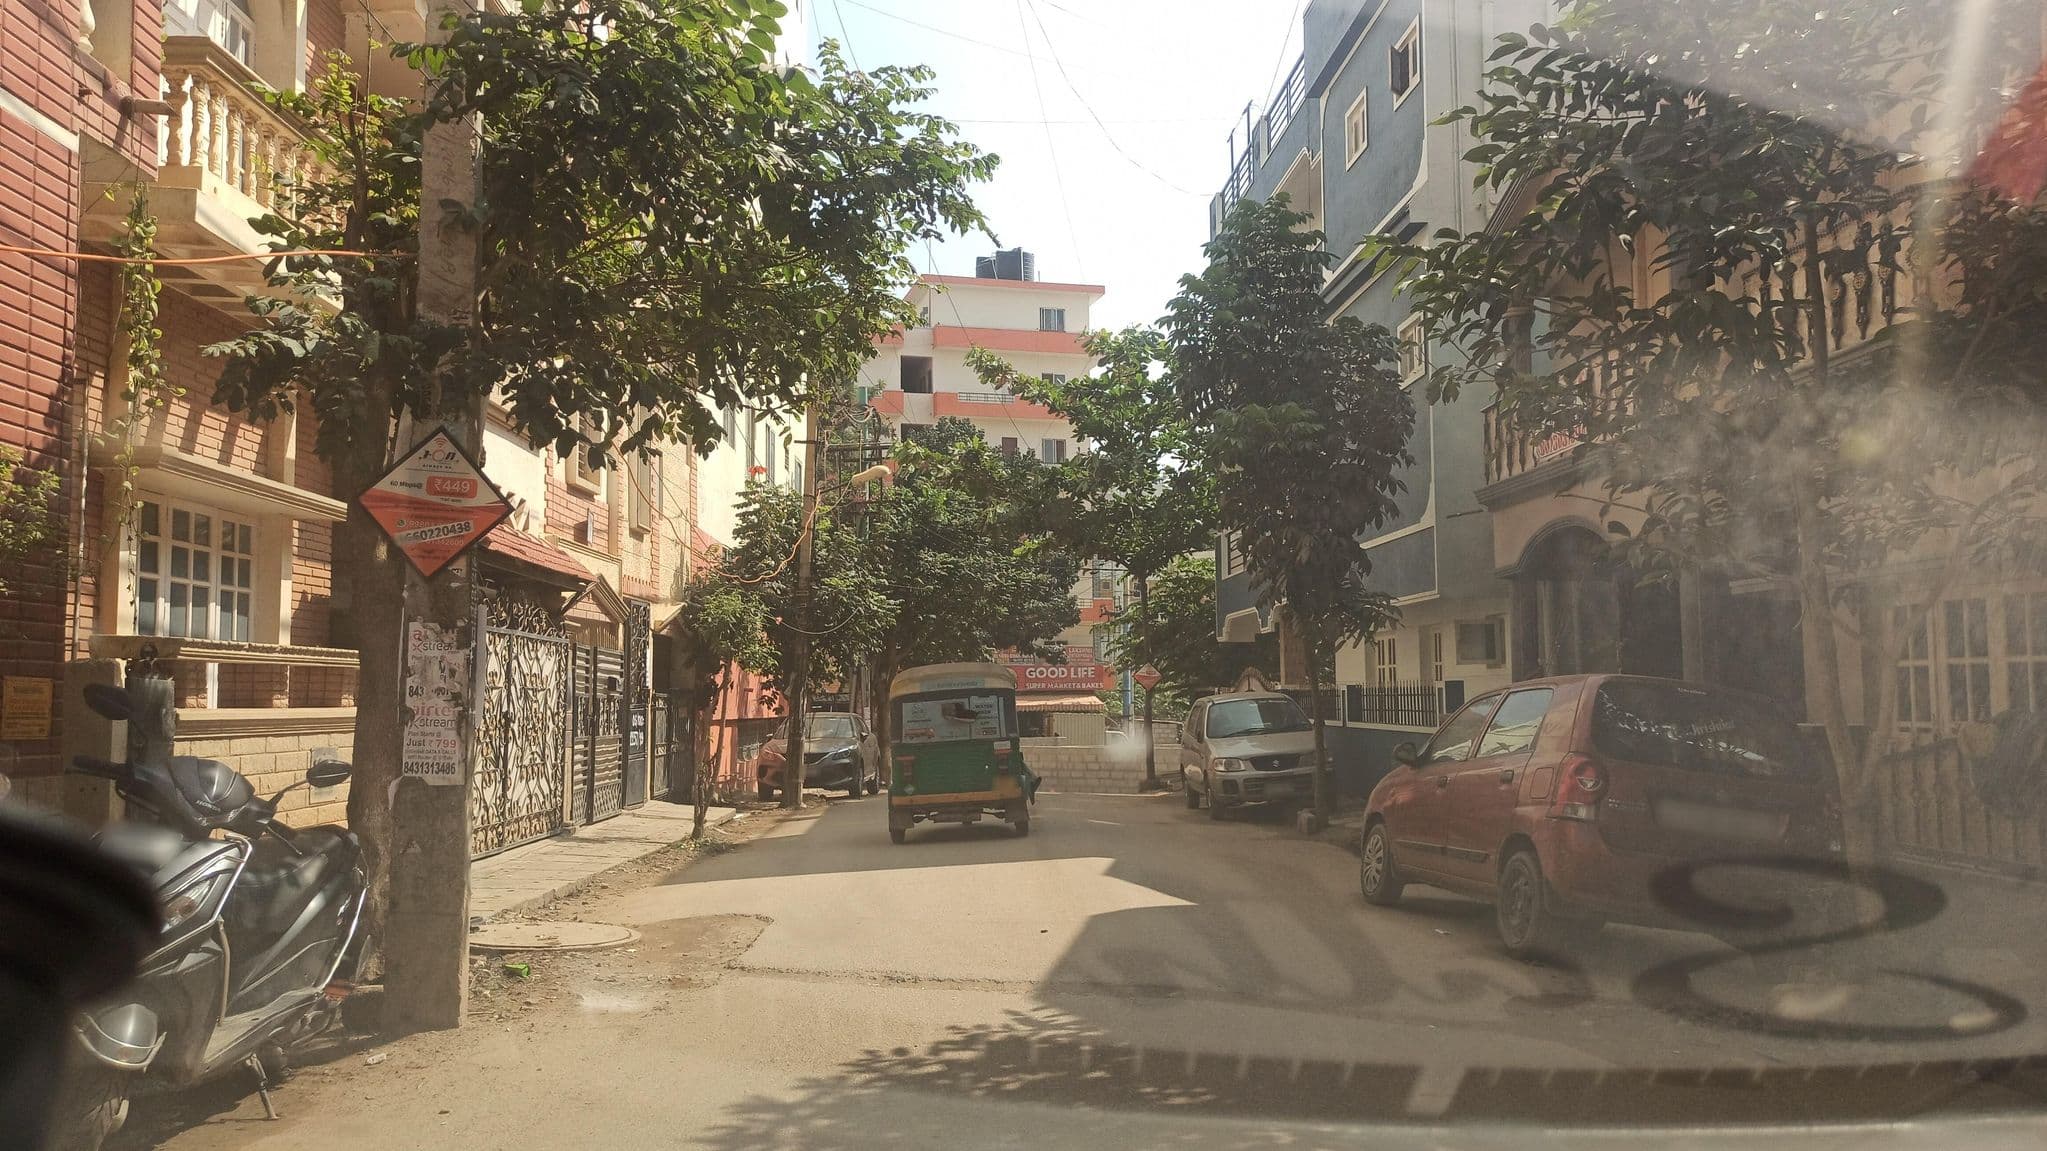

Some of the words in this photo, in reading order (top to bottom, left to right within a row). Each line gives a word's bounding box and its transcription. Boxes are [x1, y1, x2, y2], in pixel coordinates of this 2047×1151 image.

[1026, 667, 1067, 679] GOOD
[1071, 667, 1096, 679] LIFE
[1025, 682, 1047, 690] SUPER
[406, 738, 426, 747] Just
[404, 761, 456, 775] 8431313486
